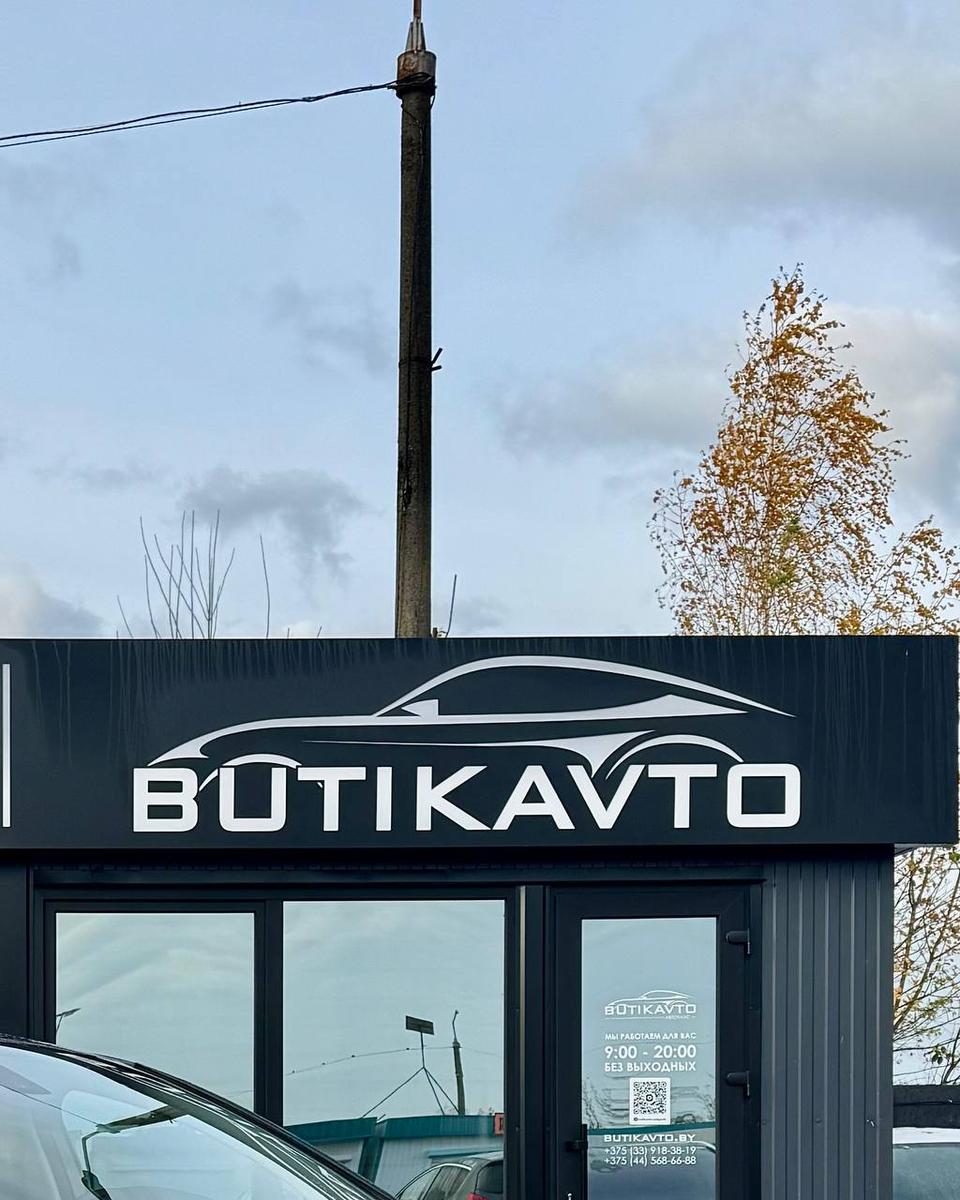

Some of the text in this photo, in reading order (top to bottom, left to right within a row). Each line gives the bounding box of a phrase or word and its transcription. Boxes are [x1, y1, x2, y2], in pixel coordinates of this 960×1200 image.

[133, 763, 801, 832] BUTIKAVTO
[605, 1004, 697, 1016] BUTIKAVTO
[605, 1032, 697, 1041] МЫ РАБОТАЕМ ДЛЯ ВАС
[604, 1045, 638, 1059] 9:00
[654, 1044, 697, 1059] 20:00
[605, 1061, 697, 1073] БЕЗ ВЫХОДНЫХ
[604, 1134, 696, 1142] BUTIKAVTO.BY
[604, 1145, 697, 1158] +375 (33) 918-38-19
[604, 1155, 697, 1167] +375 (44) 568-66-88
